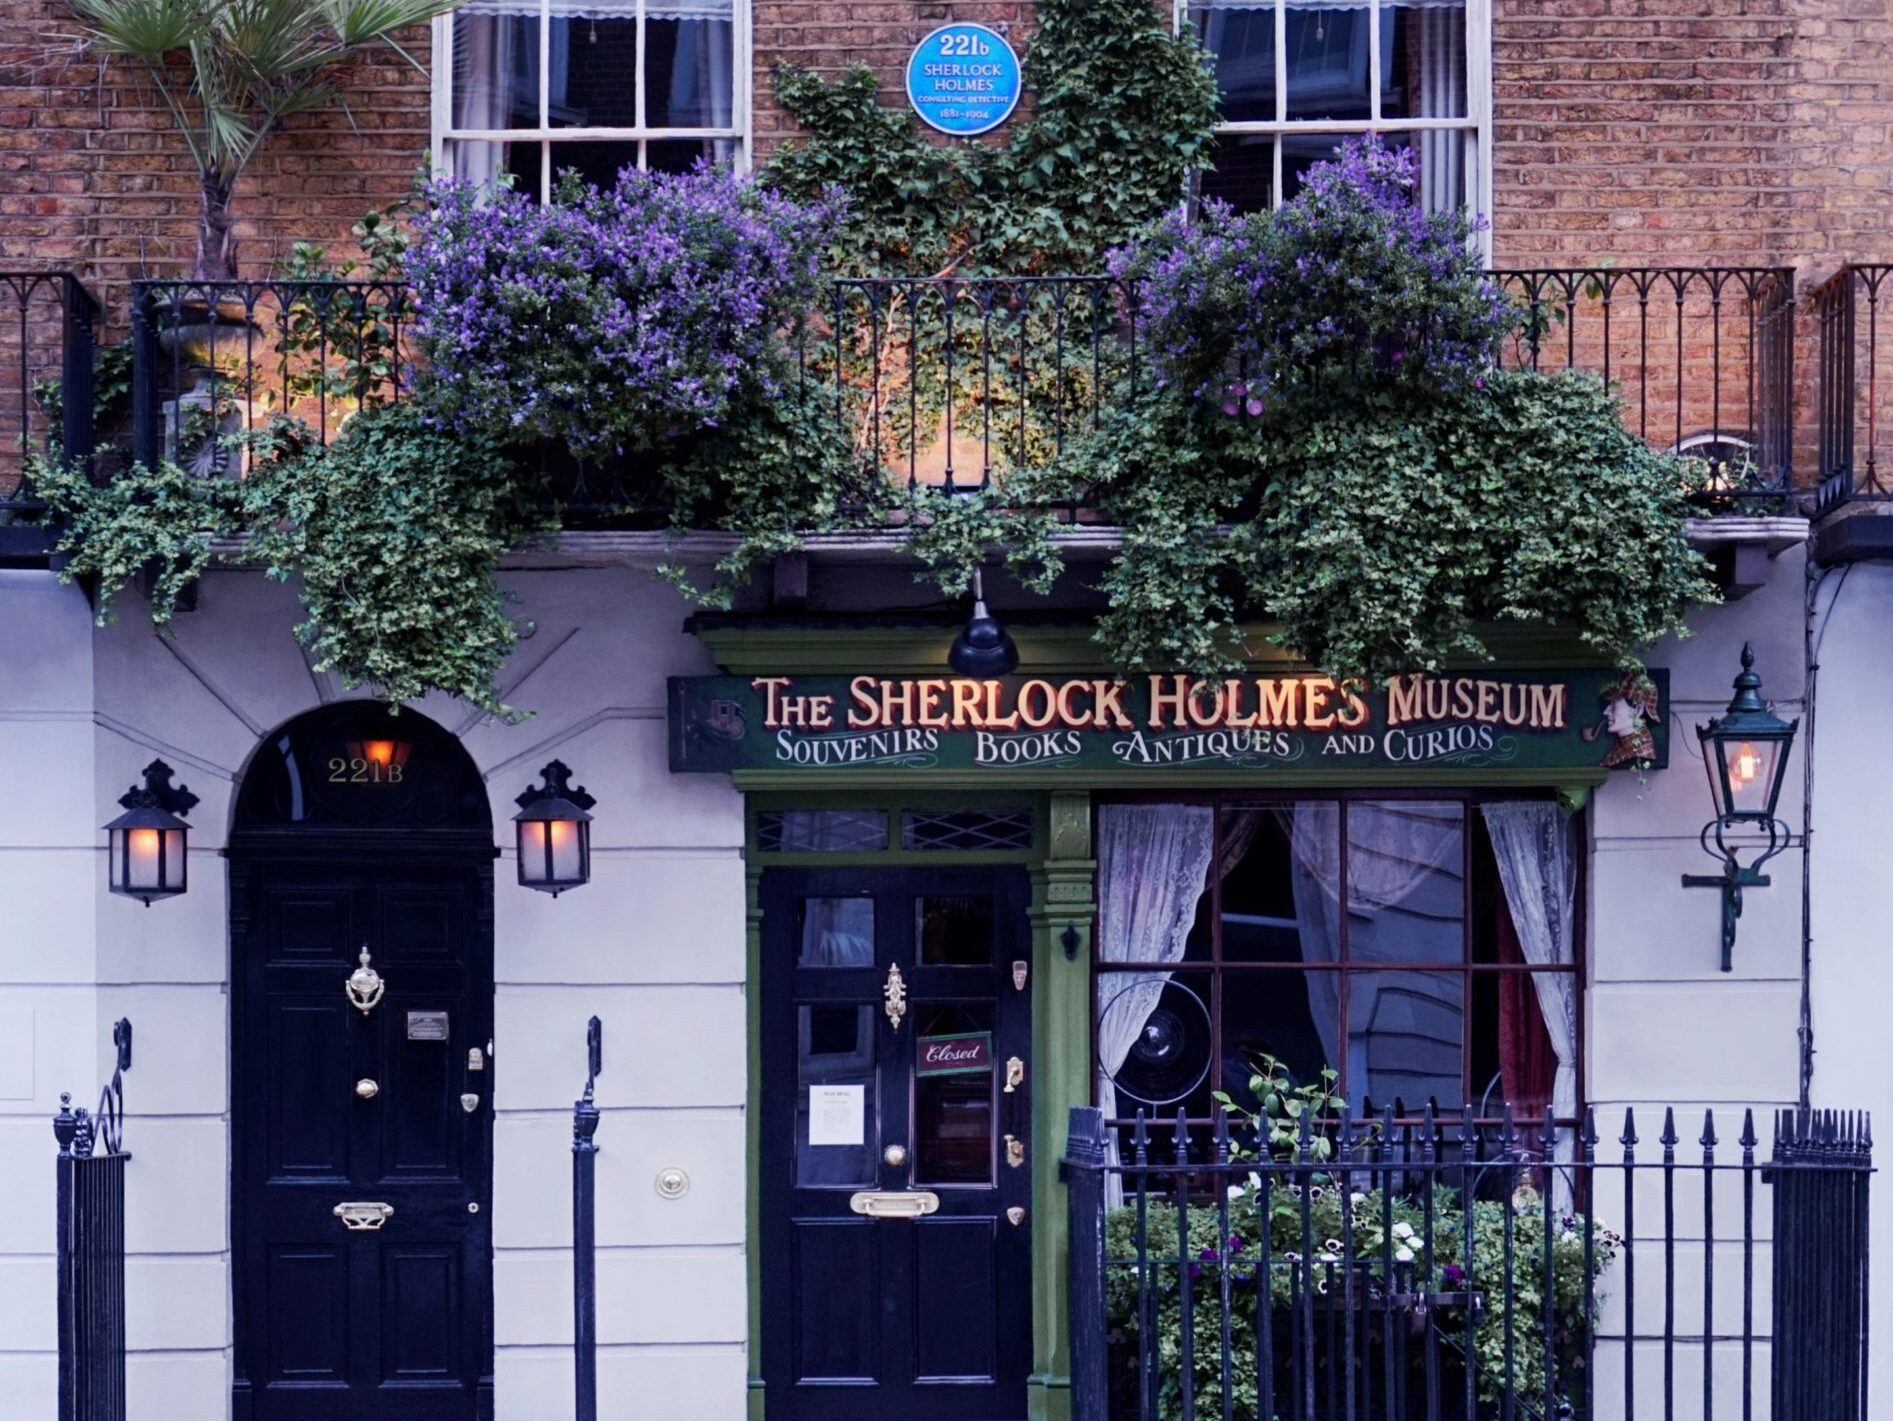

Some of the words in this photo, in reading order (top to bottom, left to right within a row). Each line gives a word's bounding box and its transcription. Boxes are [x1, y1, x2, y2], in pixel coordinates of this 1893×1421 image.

[940, 34, 990, 55] 221b
[924, 64, 1003, 77] SHERLOCK
[935, 79, 994, 91] HOLMES
[917, 95, 967, 104] CONSULTING
[967, 95, 1009, 103] DETECTIVE
[847, 675, 1133, 729] SHERLOCK
[1147, 674, 1370, 729] HOLMES
[1387, 673, 1566, 729] MUSEUM
[776, 728, 939, 765] SOUVENIRS
[975, 730, 1082, 763] BOOKS
[1112, 730, 1290, 763] ANTIQUES
[1321, 735, 1375, 755] AND
[1384, 725, 1494, 762] CURIOS
[328, 757, 403, 783] 221B
[926, 1045, 980, 1062] Closed
